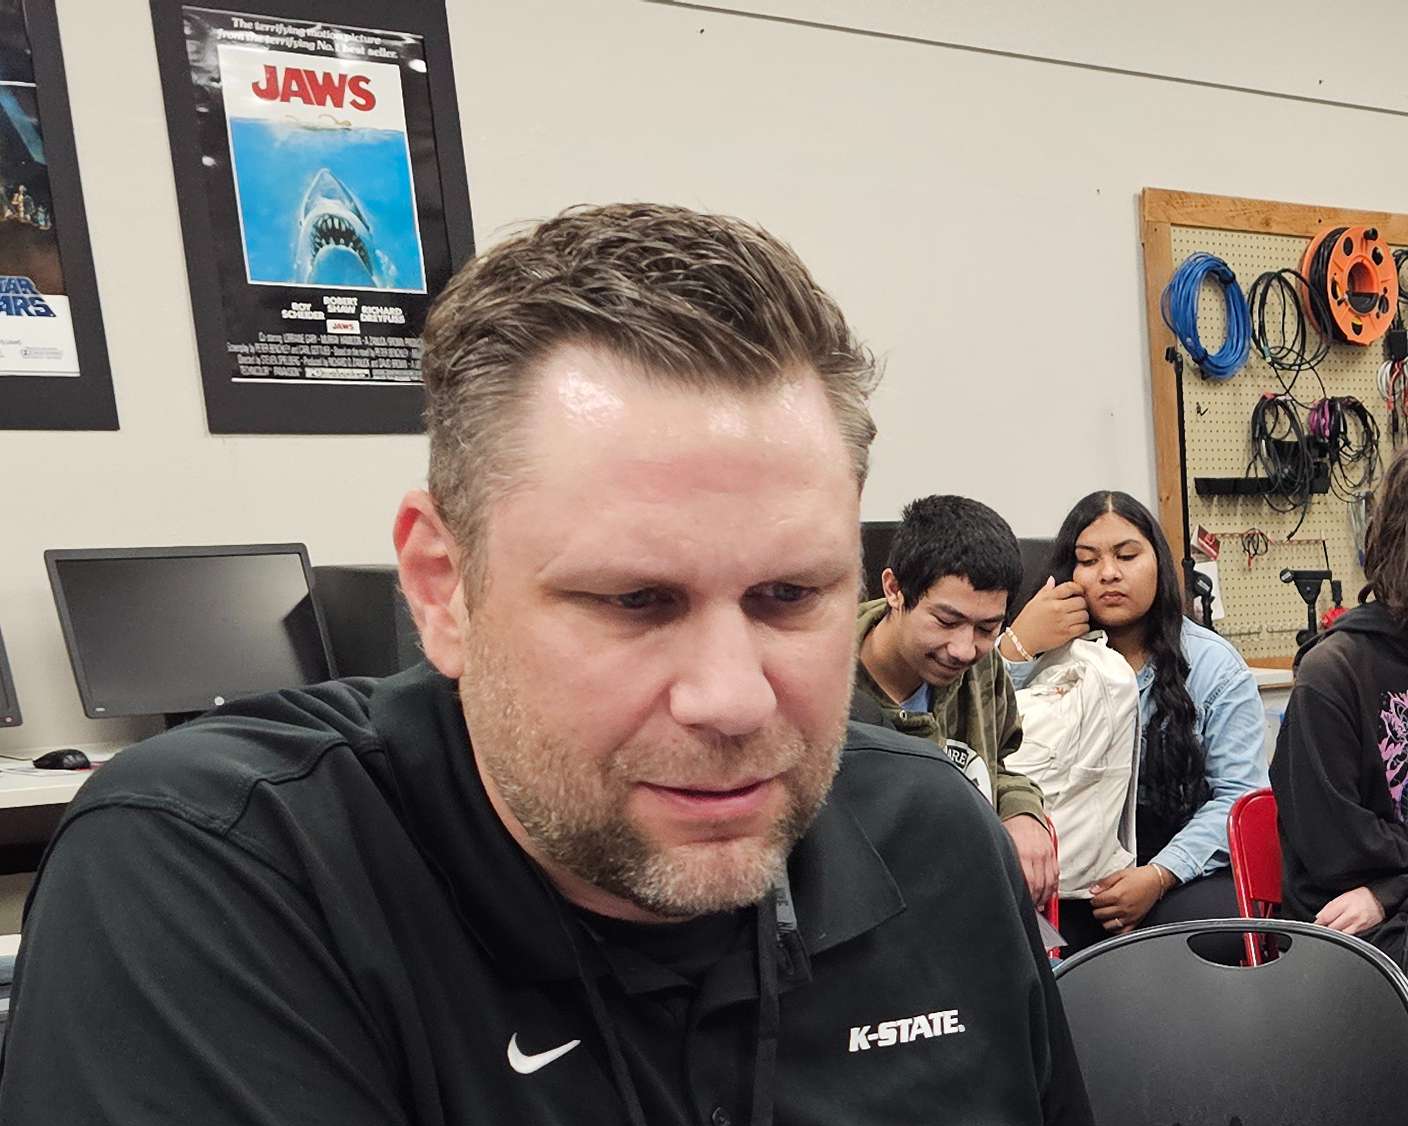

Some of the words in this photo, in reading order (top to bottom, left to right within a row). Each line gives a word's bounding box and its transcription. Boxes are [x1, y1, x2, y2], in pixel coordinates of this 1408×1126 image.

[231, 17, 254, 29] The
[254, 21, 306, 37] terrifying
[341, 33, 382, 45] picture
[264, 35, 315, 51] terrifying
[251, 64, 377, 112] JAWS
